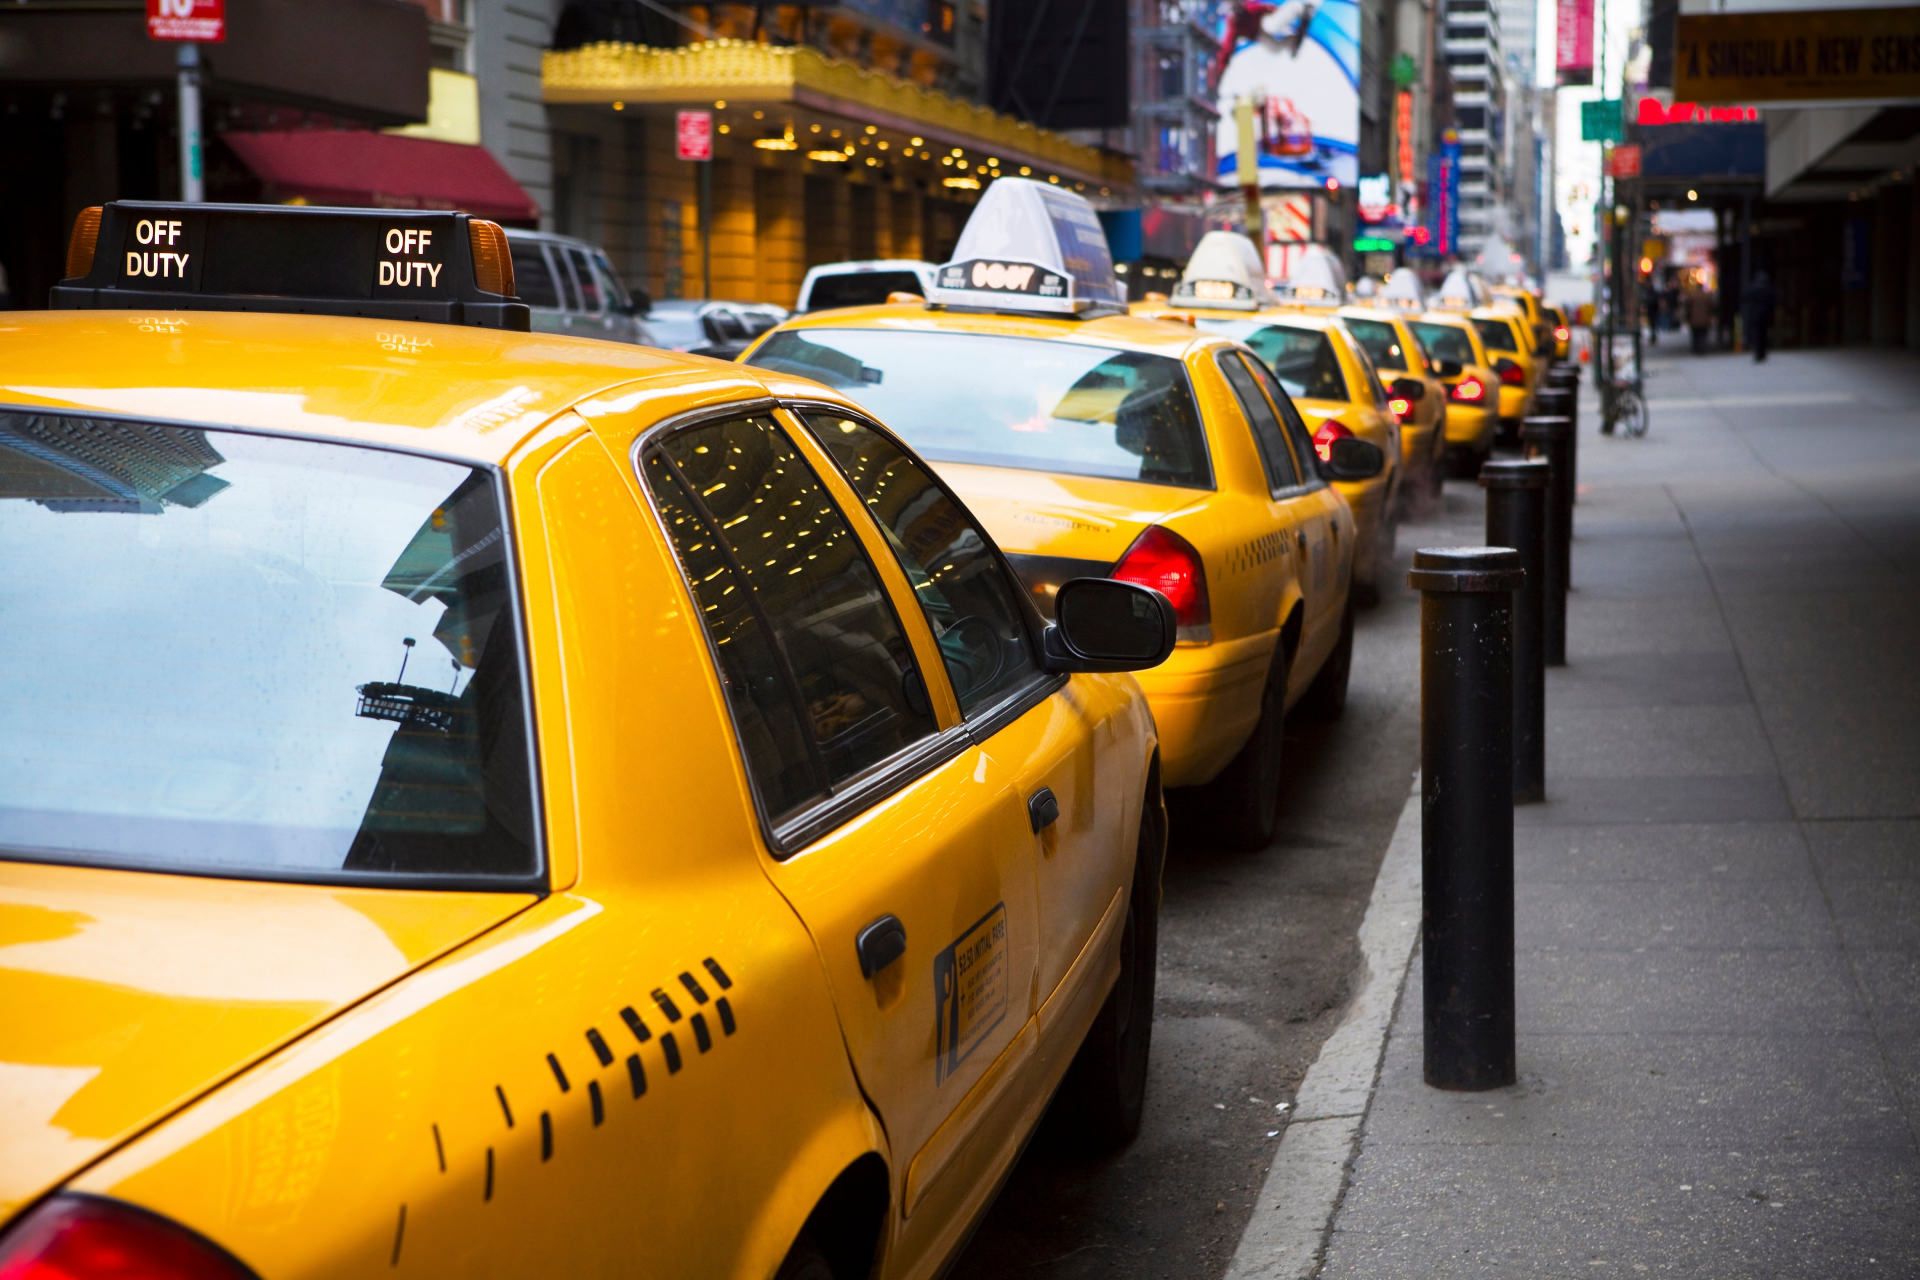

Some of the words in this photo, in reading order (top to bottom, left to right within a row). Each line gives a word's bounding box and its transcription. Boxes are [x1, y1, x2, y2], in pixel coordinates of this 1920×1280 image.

[1707, 37, 1807, 77] SINGULAR
[1816, 36, 1862, 76] NEW
[136, 219, 182, 245] OFF
[385, 228, 432, 255] OFF
[126, 252, 190, 278] DUTY
[379, 261, 443, 288] DUTY
